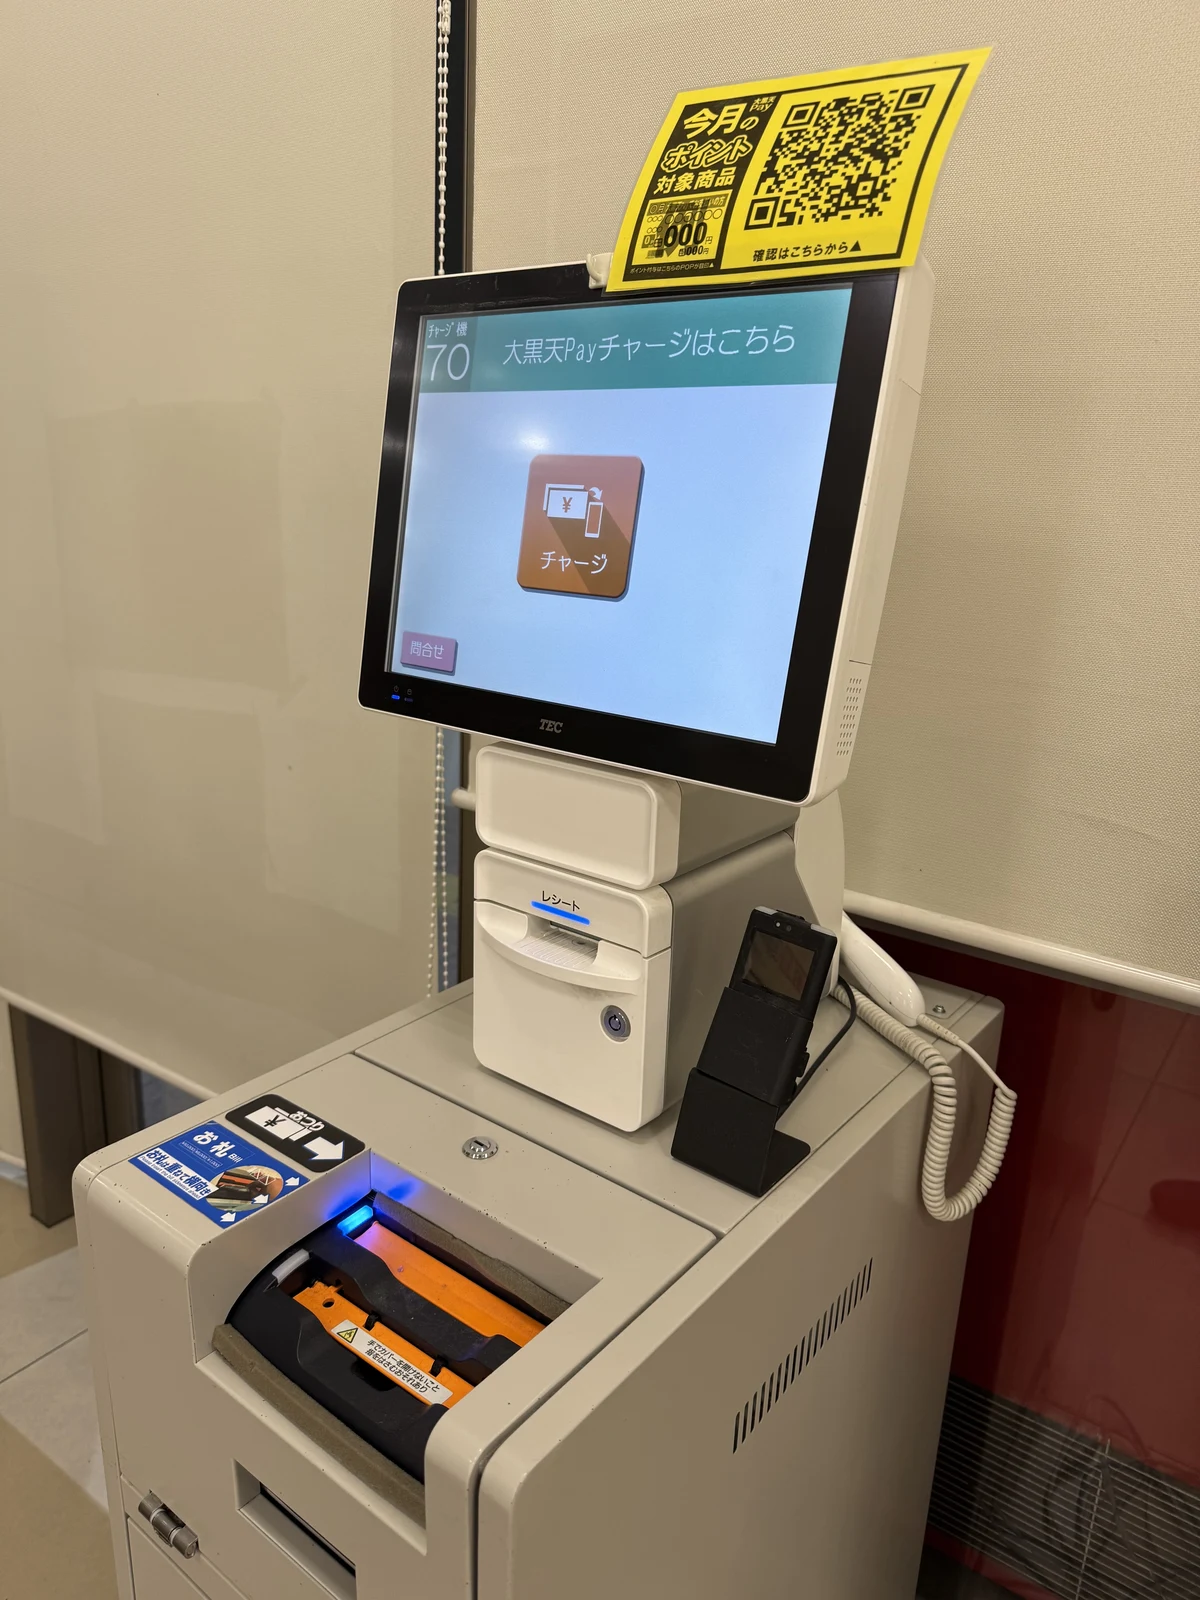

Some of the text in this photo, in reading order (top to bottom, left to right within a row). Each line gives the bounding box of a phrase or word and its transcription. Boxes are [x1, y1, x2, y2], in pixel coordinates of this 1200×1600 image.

[683, 102, 760, 140] 今月の
[661, 135, 753, 173] ポイント
[653, 166, 737, 195] 対象商品
[752, 241, 848, 262] 確認はこちらから
[502, 324, 796, 366] 大黒天Payチャージはこちら
[426, 343, 470, 381] 70
[540, 550, 608, 575] チャージ
[410, 640, 445, 660] 問合せ
[539, 718, 564, 734] TEC
[541, 890, 581, 912] レシート
[288, 1110, 325, 1132] おつり
[193, 1130, 236, 1158] お札
[227, 1152, 243, 1164] Bill
[364, 1348, 429, 1394] 指をはさむおそれあり
[367, 1339, 441, 1393] 手でカバーを開けないこと
